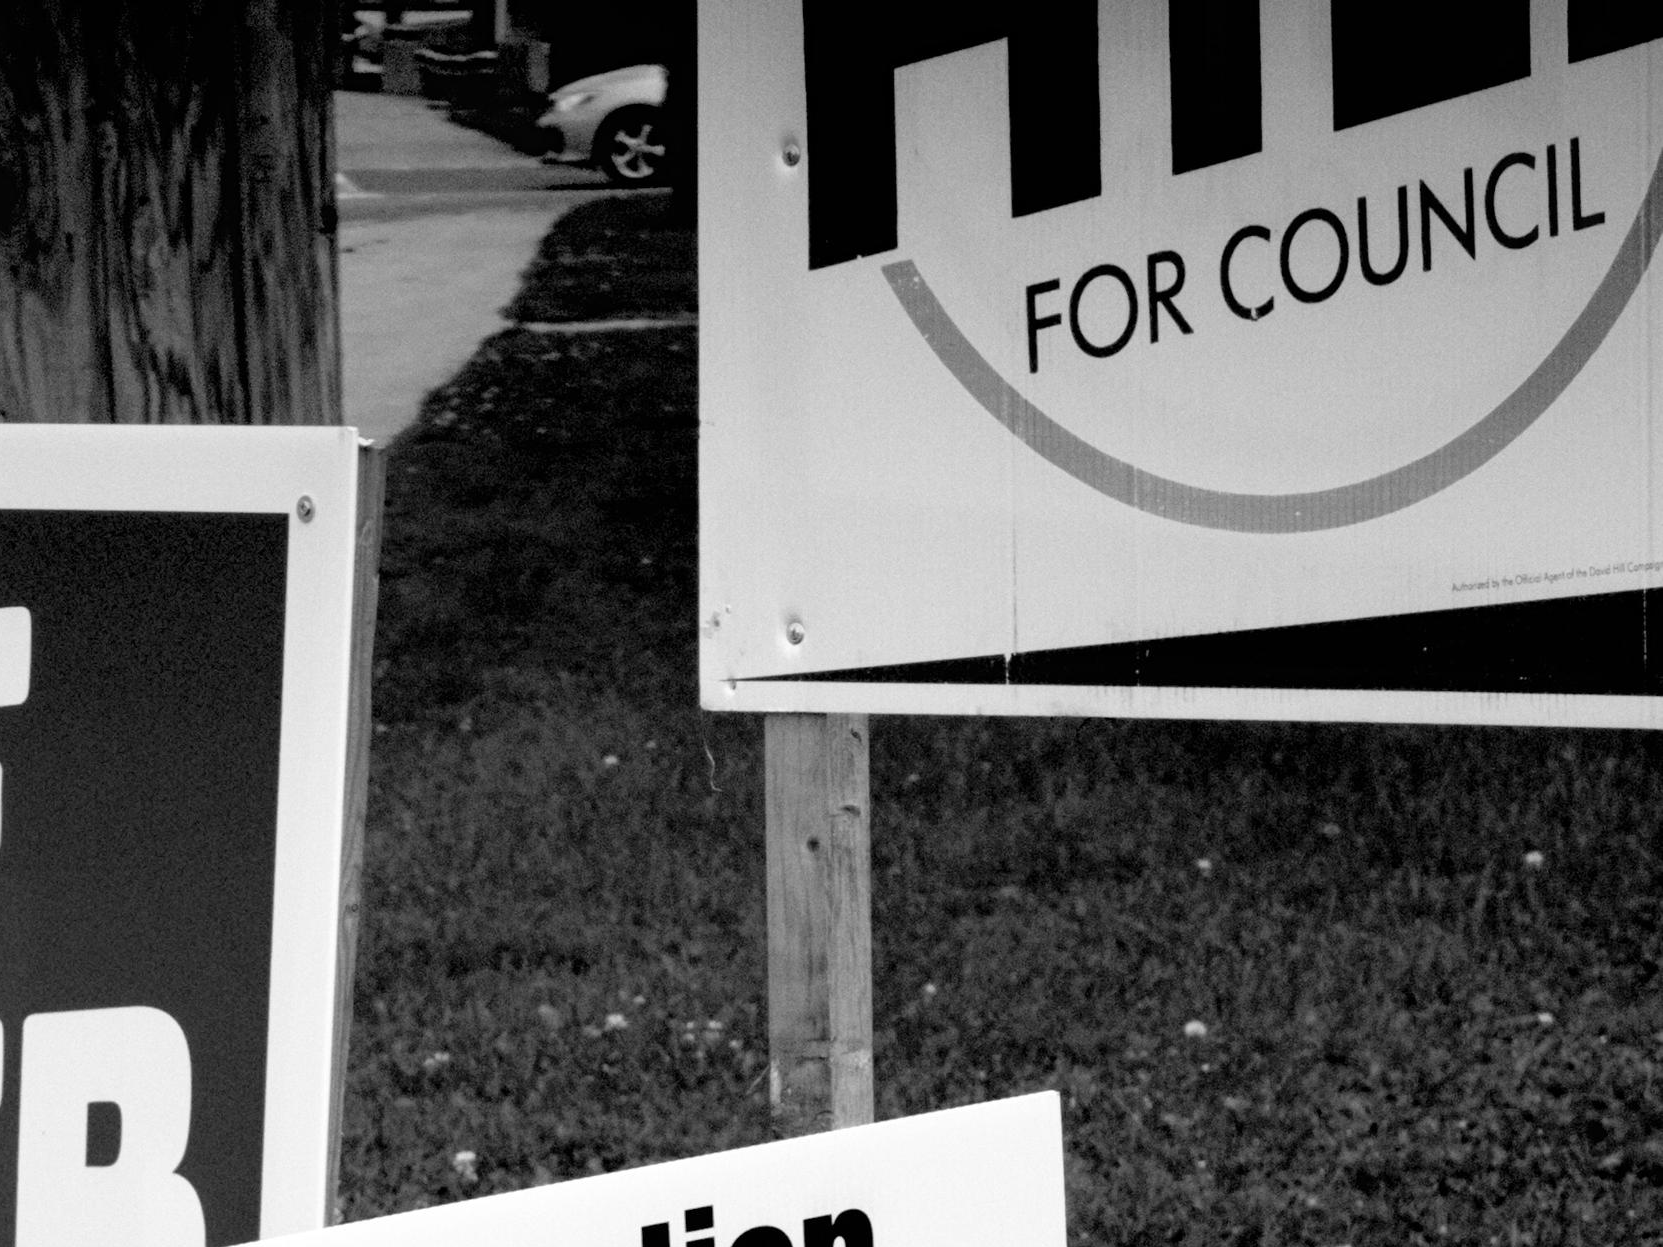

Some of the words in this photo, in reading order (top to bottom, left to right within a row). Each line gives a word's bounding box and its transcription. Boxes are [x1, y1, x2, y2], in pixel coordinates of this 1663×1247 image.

[1025, 249, 1194, 374] FOR
[1219, 136, 1606, 322] COUNCIL
[1502, 576, 1514, 587] the
[1515, 572, 1541, 585] Official
[1544, 571, 1565, 584] Agent
[1566, 568, 1574, 579] of
[1576, 567, 1587, 578] the
[1589, 564, 1611, 577] David
[1613, 562, 1625, 574] Hill
